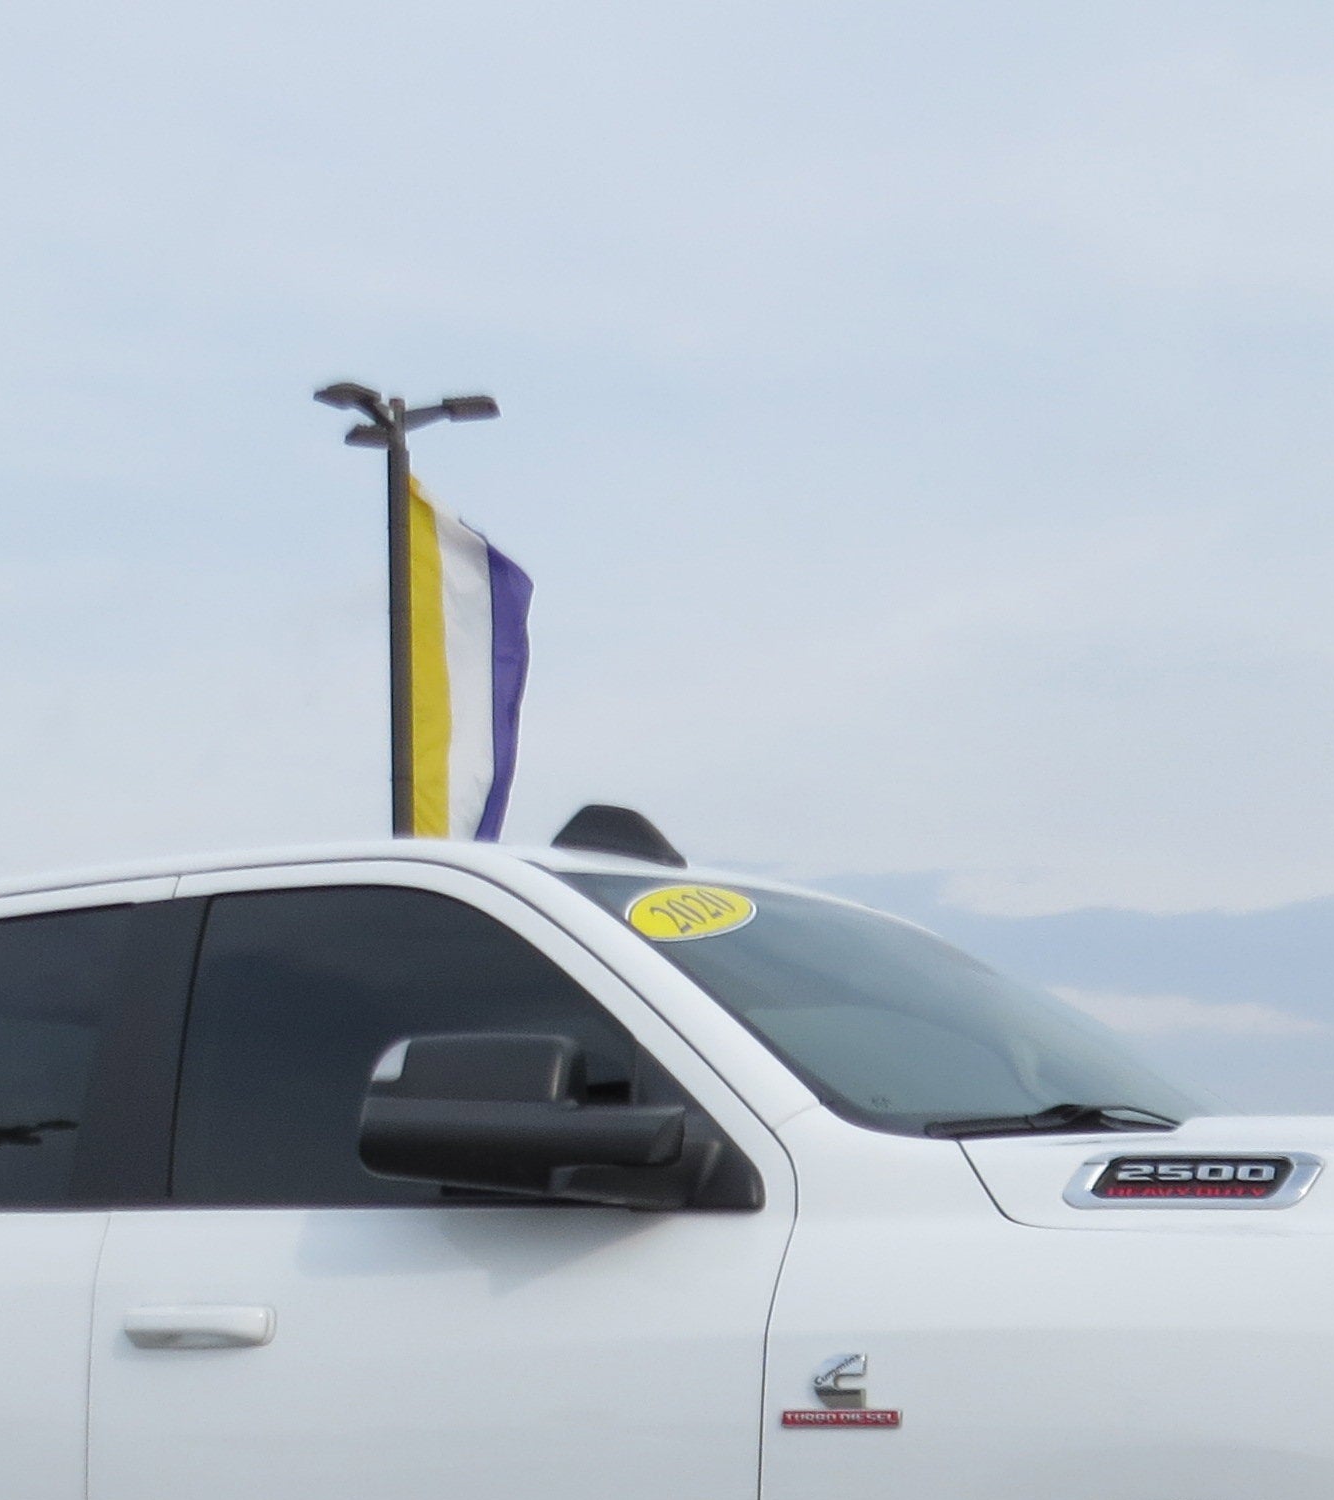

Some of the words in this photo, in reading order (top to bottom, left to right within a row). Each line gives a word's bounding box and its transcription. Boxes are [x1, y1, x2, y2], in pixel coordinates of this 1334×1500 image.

[649, 889, 736, 934] 2020
[1117, 1163, 1276, 1182] 2500
[1104, 1186, 1190, 1198] HEAVY
[1195, 1186, 1267, 1198] DUTY
[784, 1412, 837, 1425] TURBO
[839, 1412, 898, 1425] DIESEL
